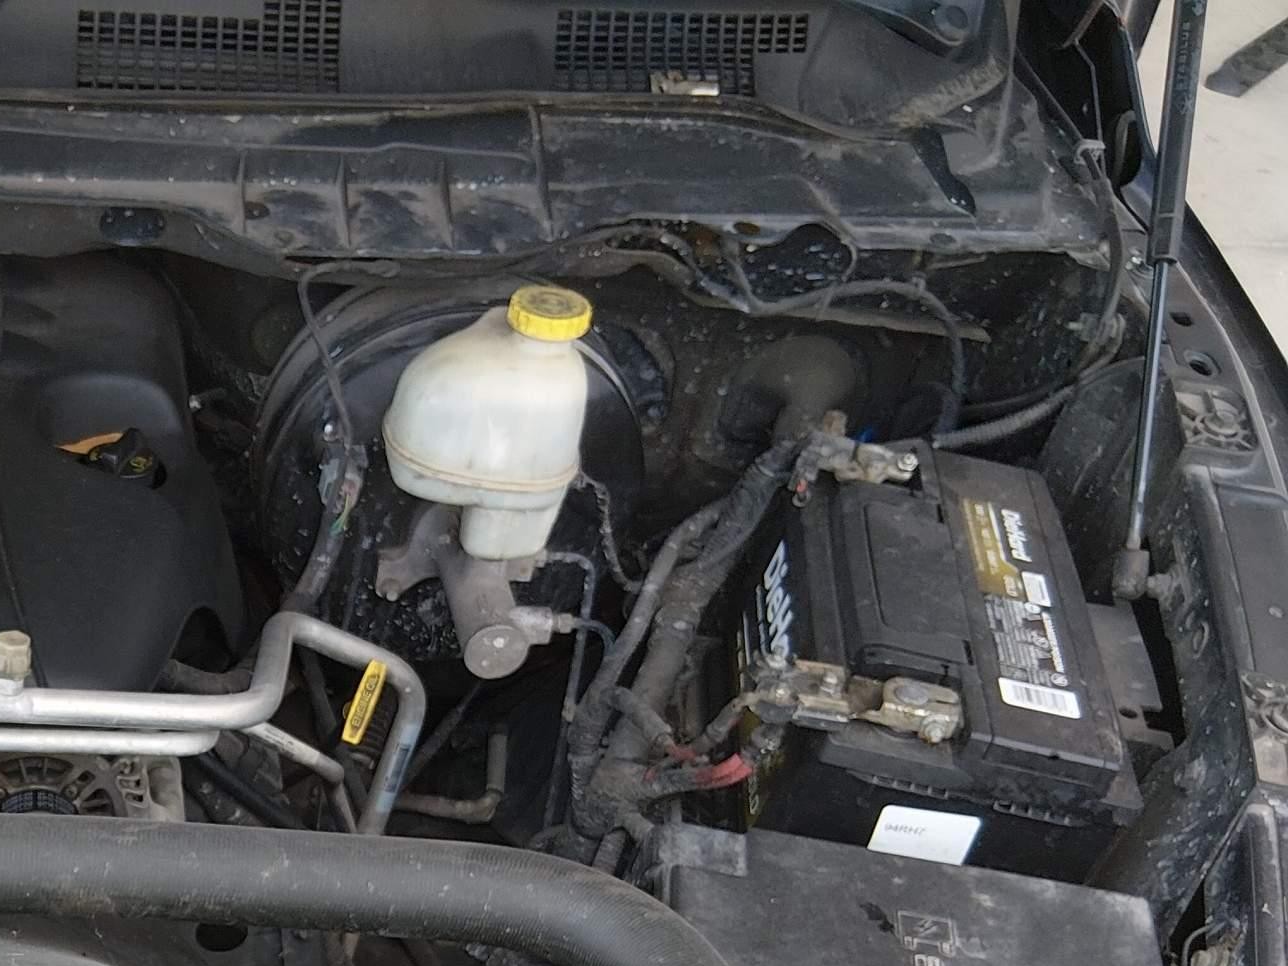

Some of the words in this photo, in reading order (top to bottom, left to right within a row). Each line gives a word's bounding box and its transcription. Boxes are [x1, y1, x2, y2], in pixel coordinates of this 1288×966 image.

[1001, 509, 1032, 562] DieHard
[763, 540, 793, 660] DieH
[352, 690, 371, 727] ENGINE
[366, 674, 379, 691] OIL
